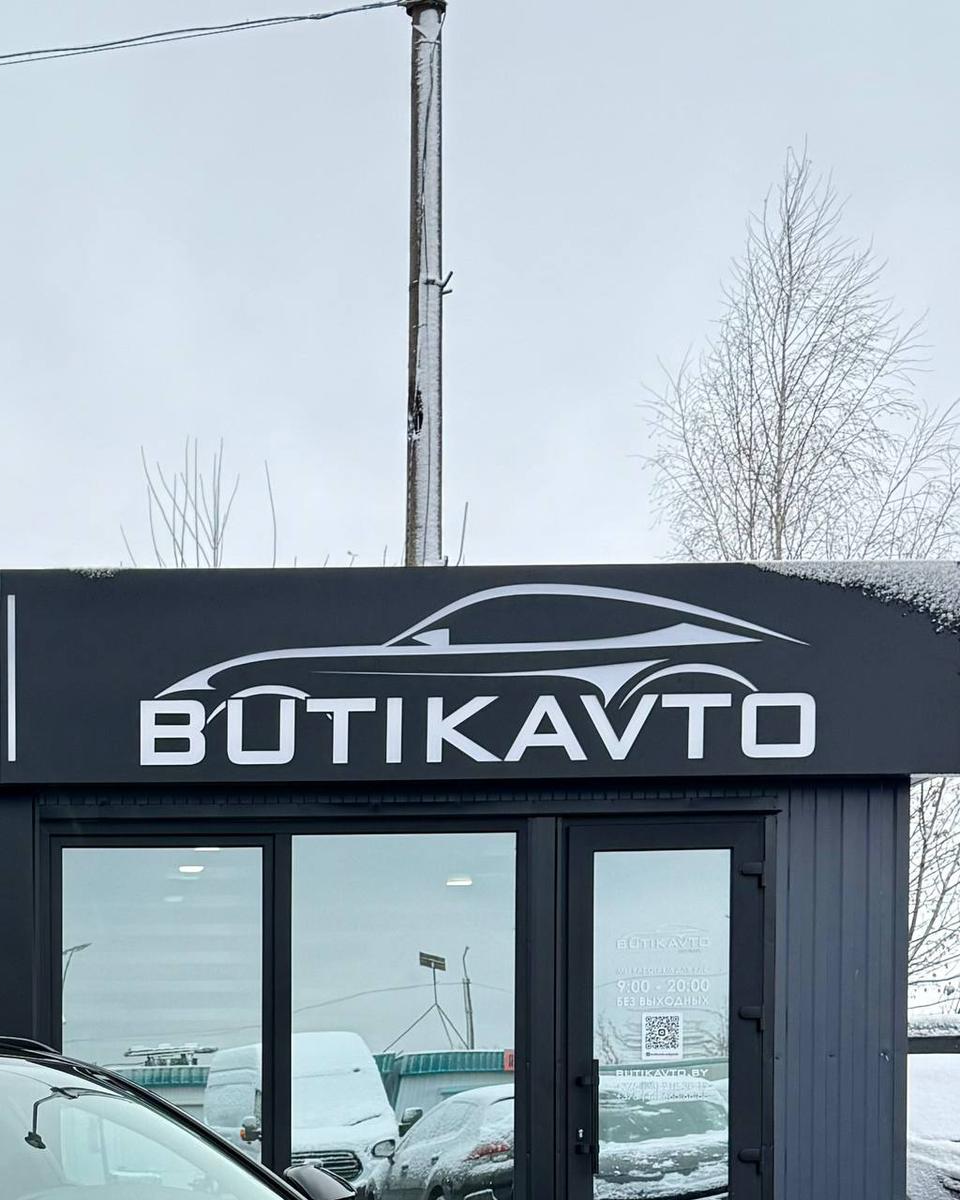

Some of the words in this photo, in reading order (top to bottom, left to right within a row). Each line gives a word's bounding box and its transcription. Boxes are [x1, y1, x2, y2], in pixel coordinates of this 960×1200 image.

[139, 691, 817, 767] BUTIKAVTO
[616, 979, 650, 994] 9:00
[667, 978, 709, 993] 20:00
[616, 996, 636, 1007] БЕЗ
[638, 995, 710, 1008] ВЫХОДНЫХ
